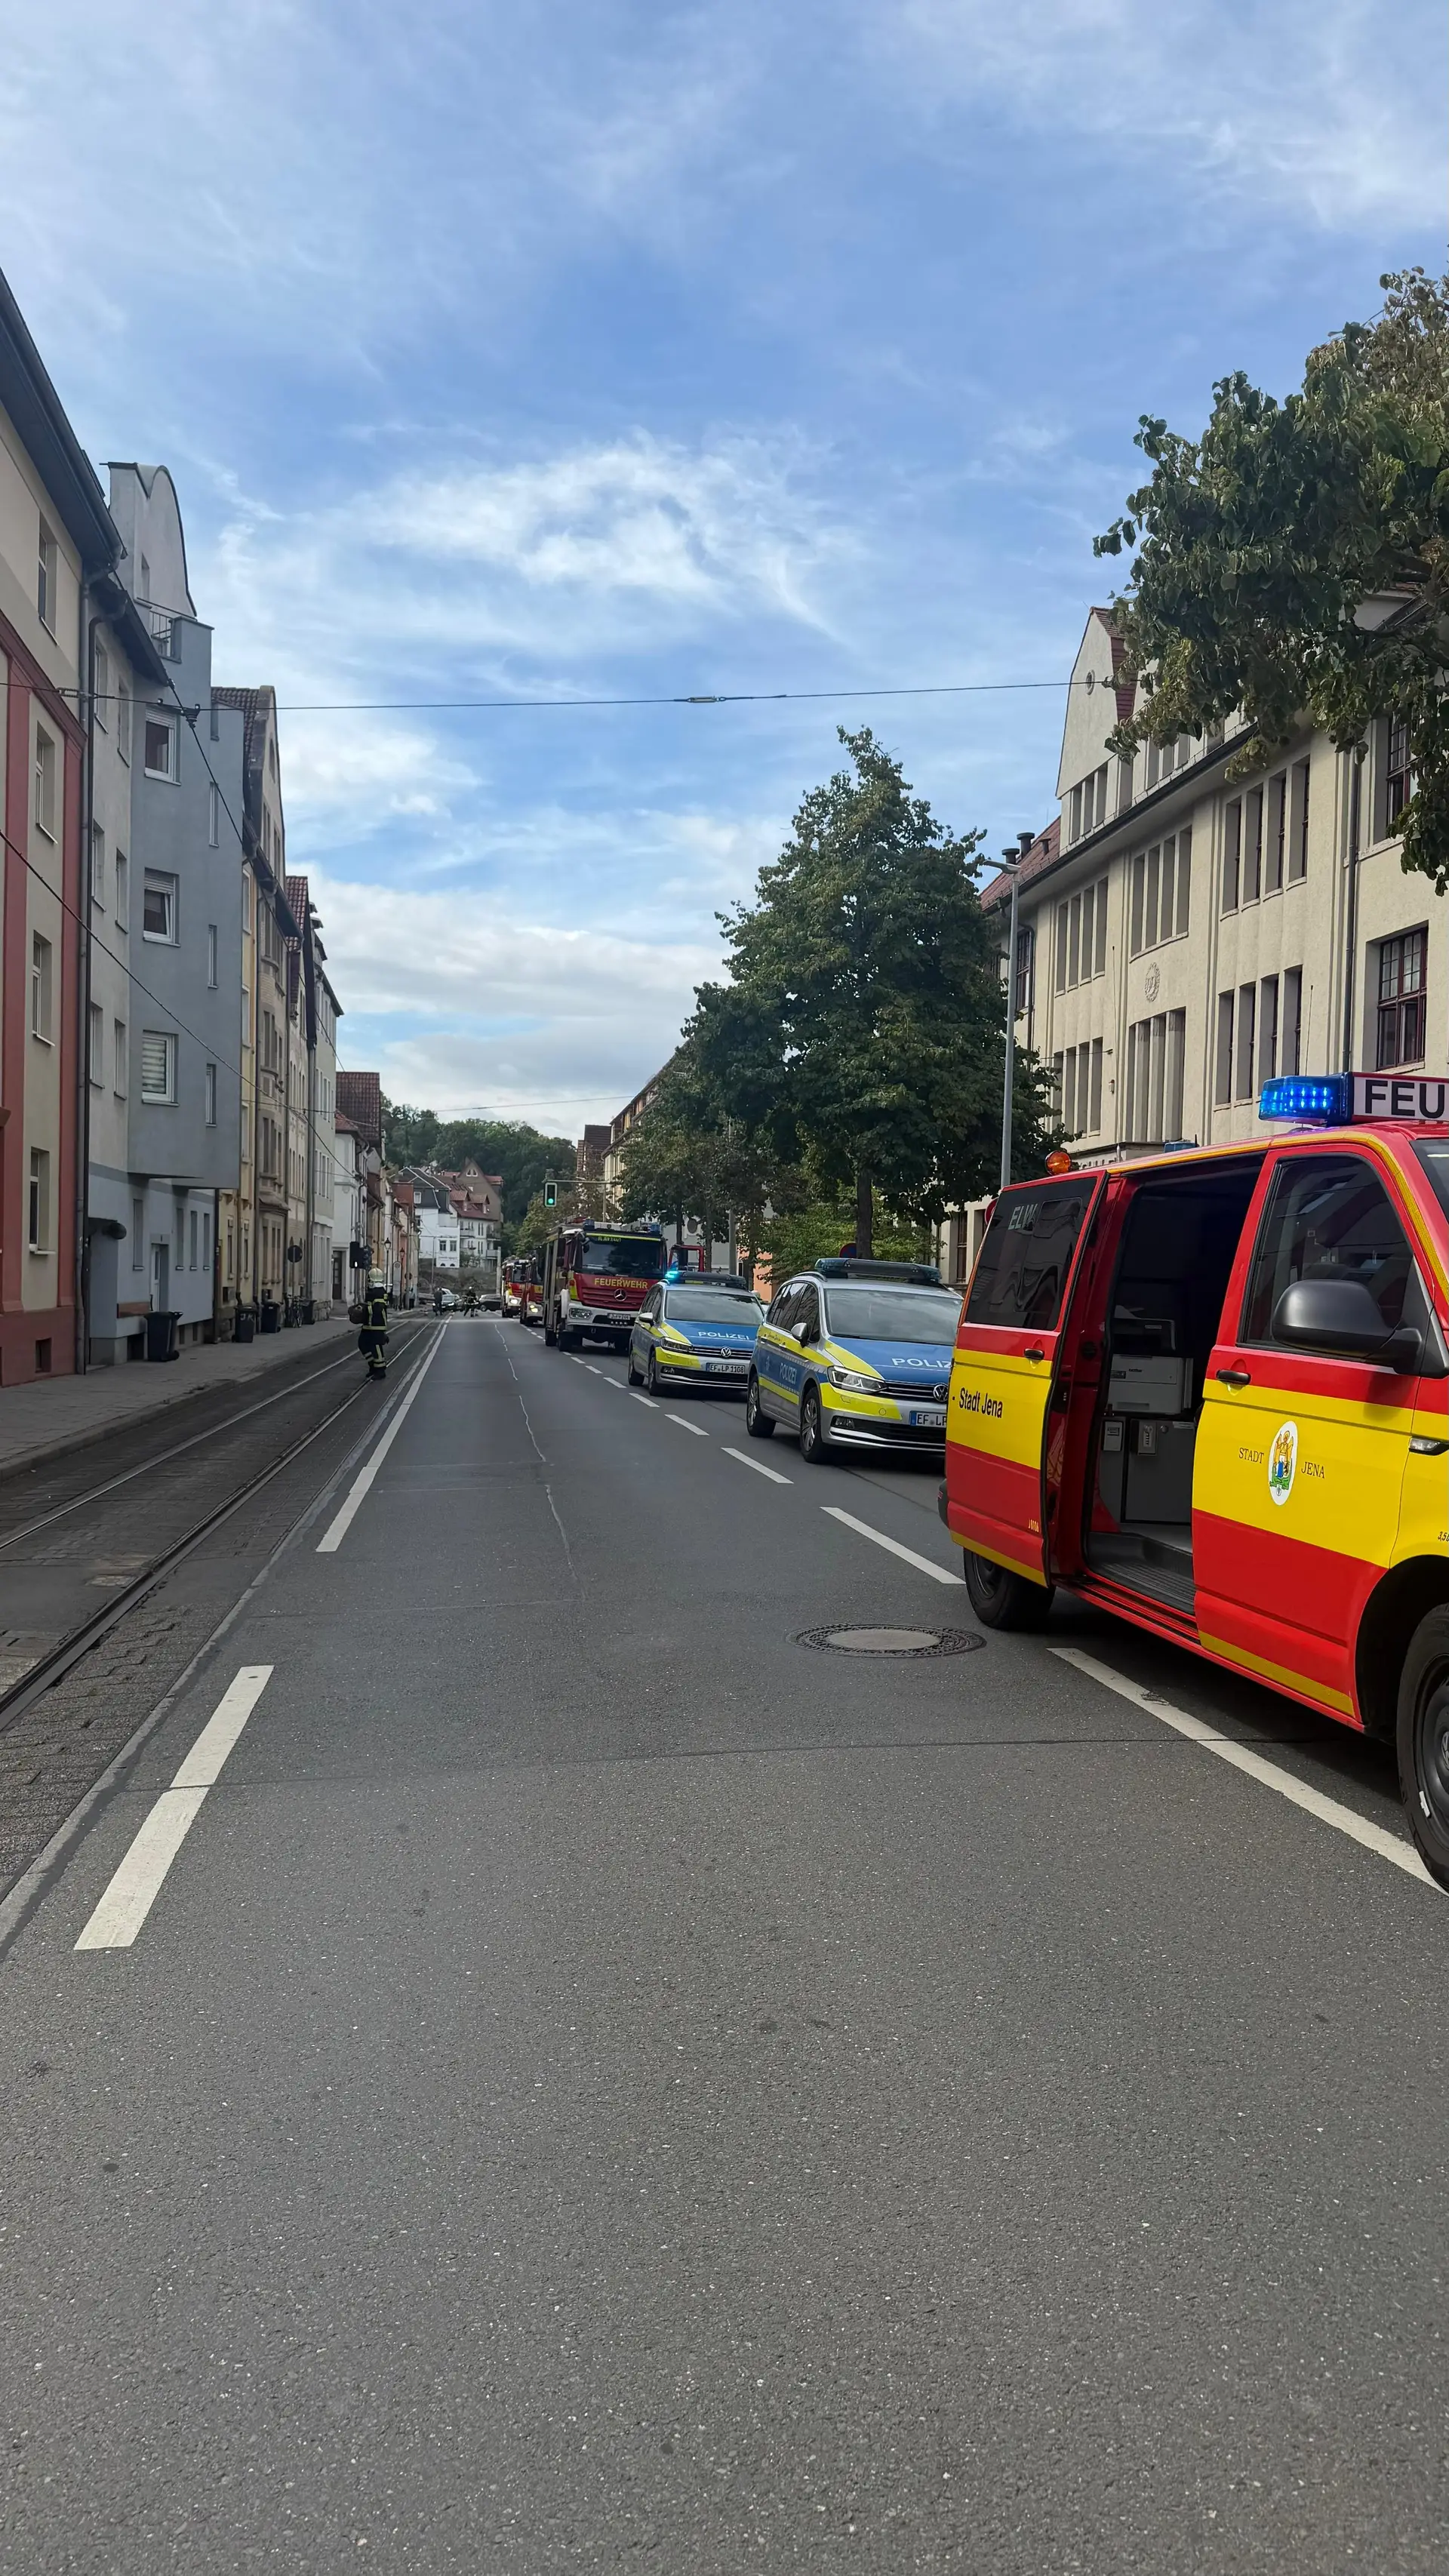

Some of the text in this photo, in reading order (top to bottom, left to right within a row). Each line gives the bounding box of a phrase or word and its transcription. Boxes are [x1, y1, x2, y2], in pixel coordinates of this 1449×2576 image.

[1365, 1079, 1445, 1119] FEU
[594, 1278, 648, 1289] FEUERWEHR
[698, 1331, 749, 1340] POLIZEI
[780, 1362, 797, 1384] POLIZEI
[959, 1387, 1003, 1419] Stadt Jena
[917, 1414, 929, 1425] EF
[1238, 1447, 1265, 1464] STADT
[1301, 1461, 1325, 1479] JENA
